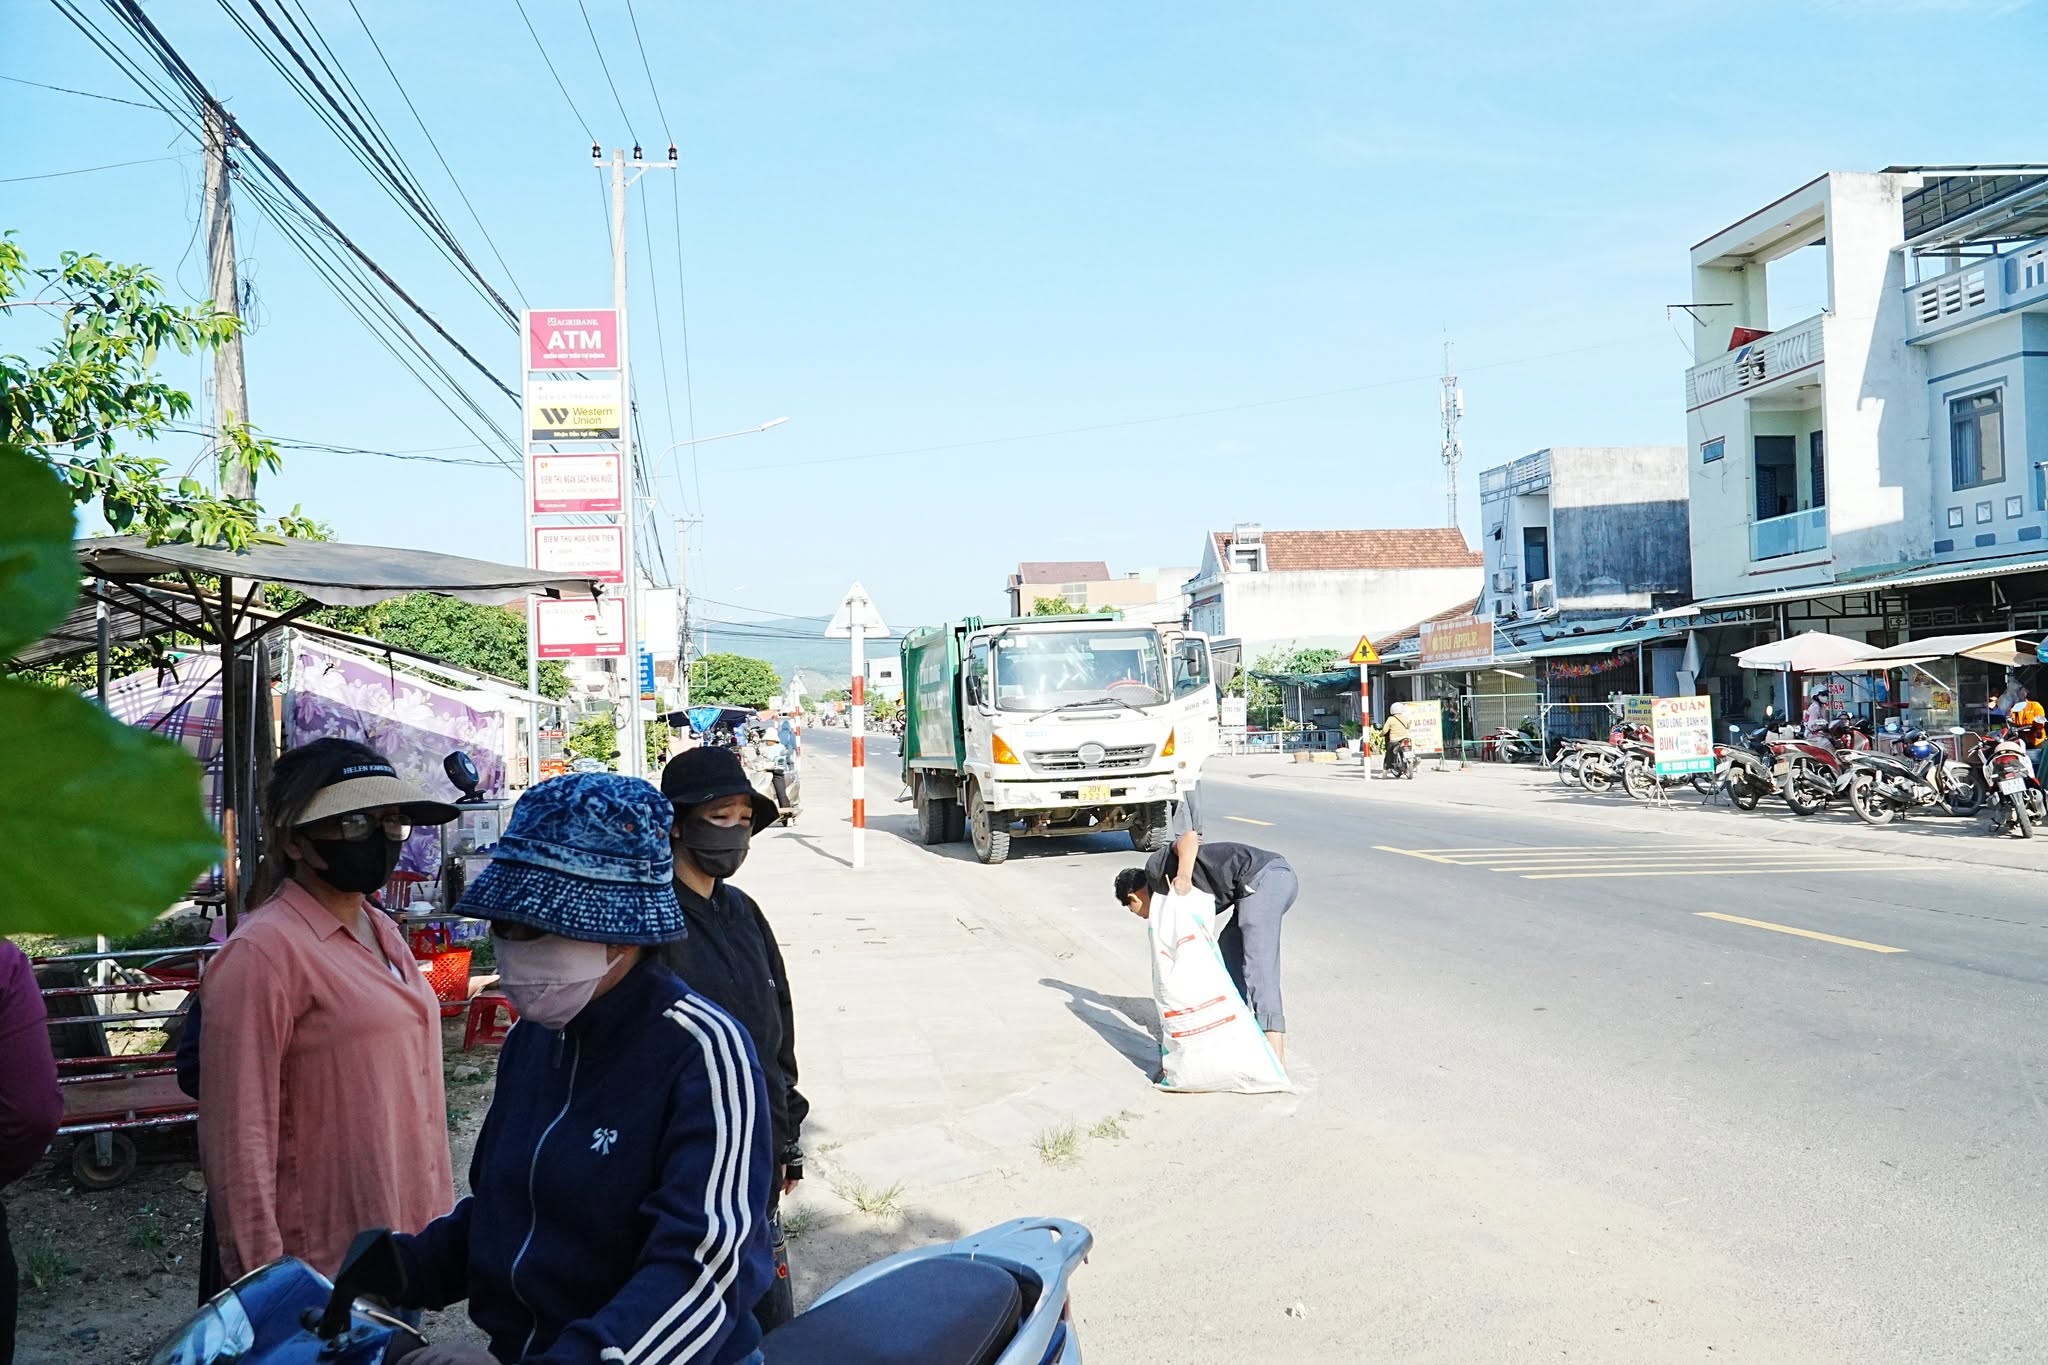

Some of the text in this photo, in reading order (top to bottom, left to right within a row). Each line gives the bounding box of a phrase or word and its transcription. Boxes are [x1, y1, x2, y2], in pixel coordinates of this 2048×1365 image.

[547, 330, 602, 350] ATM
[572, 407, 613, 416] Western
[573, 416, 602, 425] Union
[1453, 631, 1478, 649] APPLE
[343, 765, 369, 775] HELEN
